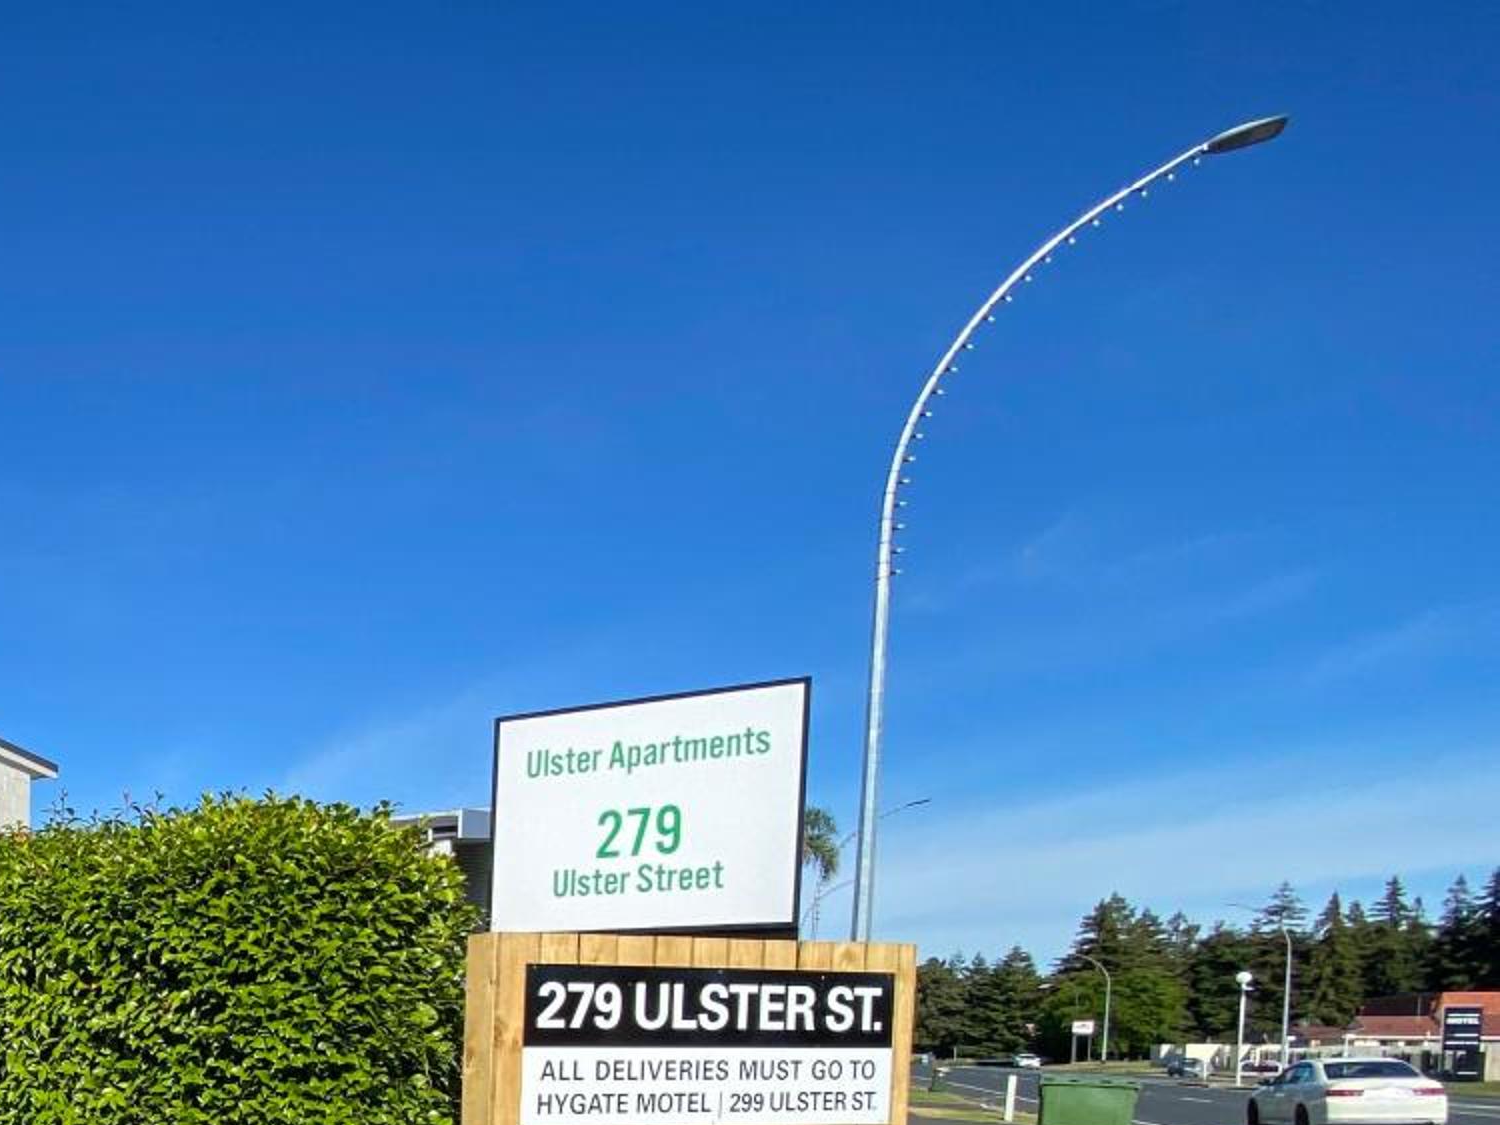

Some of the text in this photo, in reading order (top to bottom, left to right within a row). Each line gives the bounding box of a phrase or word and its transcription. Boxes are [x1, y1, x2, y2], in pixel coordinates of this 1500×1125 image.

[526, 728, 771, 779] Ulster Apartments
[596, 804, 682, 859] 279
[553, 861, 724, 898] Ulster Street
[536, 981, 883, 1032] 279 ULSTER ST.
[540, 1059, 876, 1081] ALL DELIVERIES MUST GO TO
[537, 1092, 629, 1115] HYGATE
[636, 1092, 711, 1114] MOTEL
[729, 1092, 765, 1113] 299
[769, 1091, 847, 1112] ULSTER
